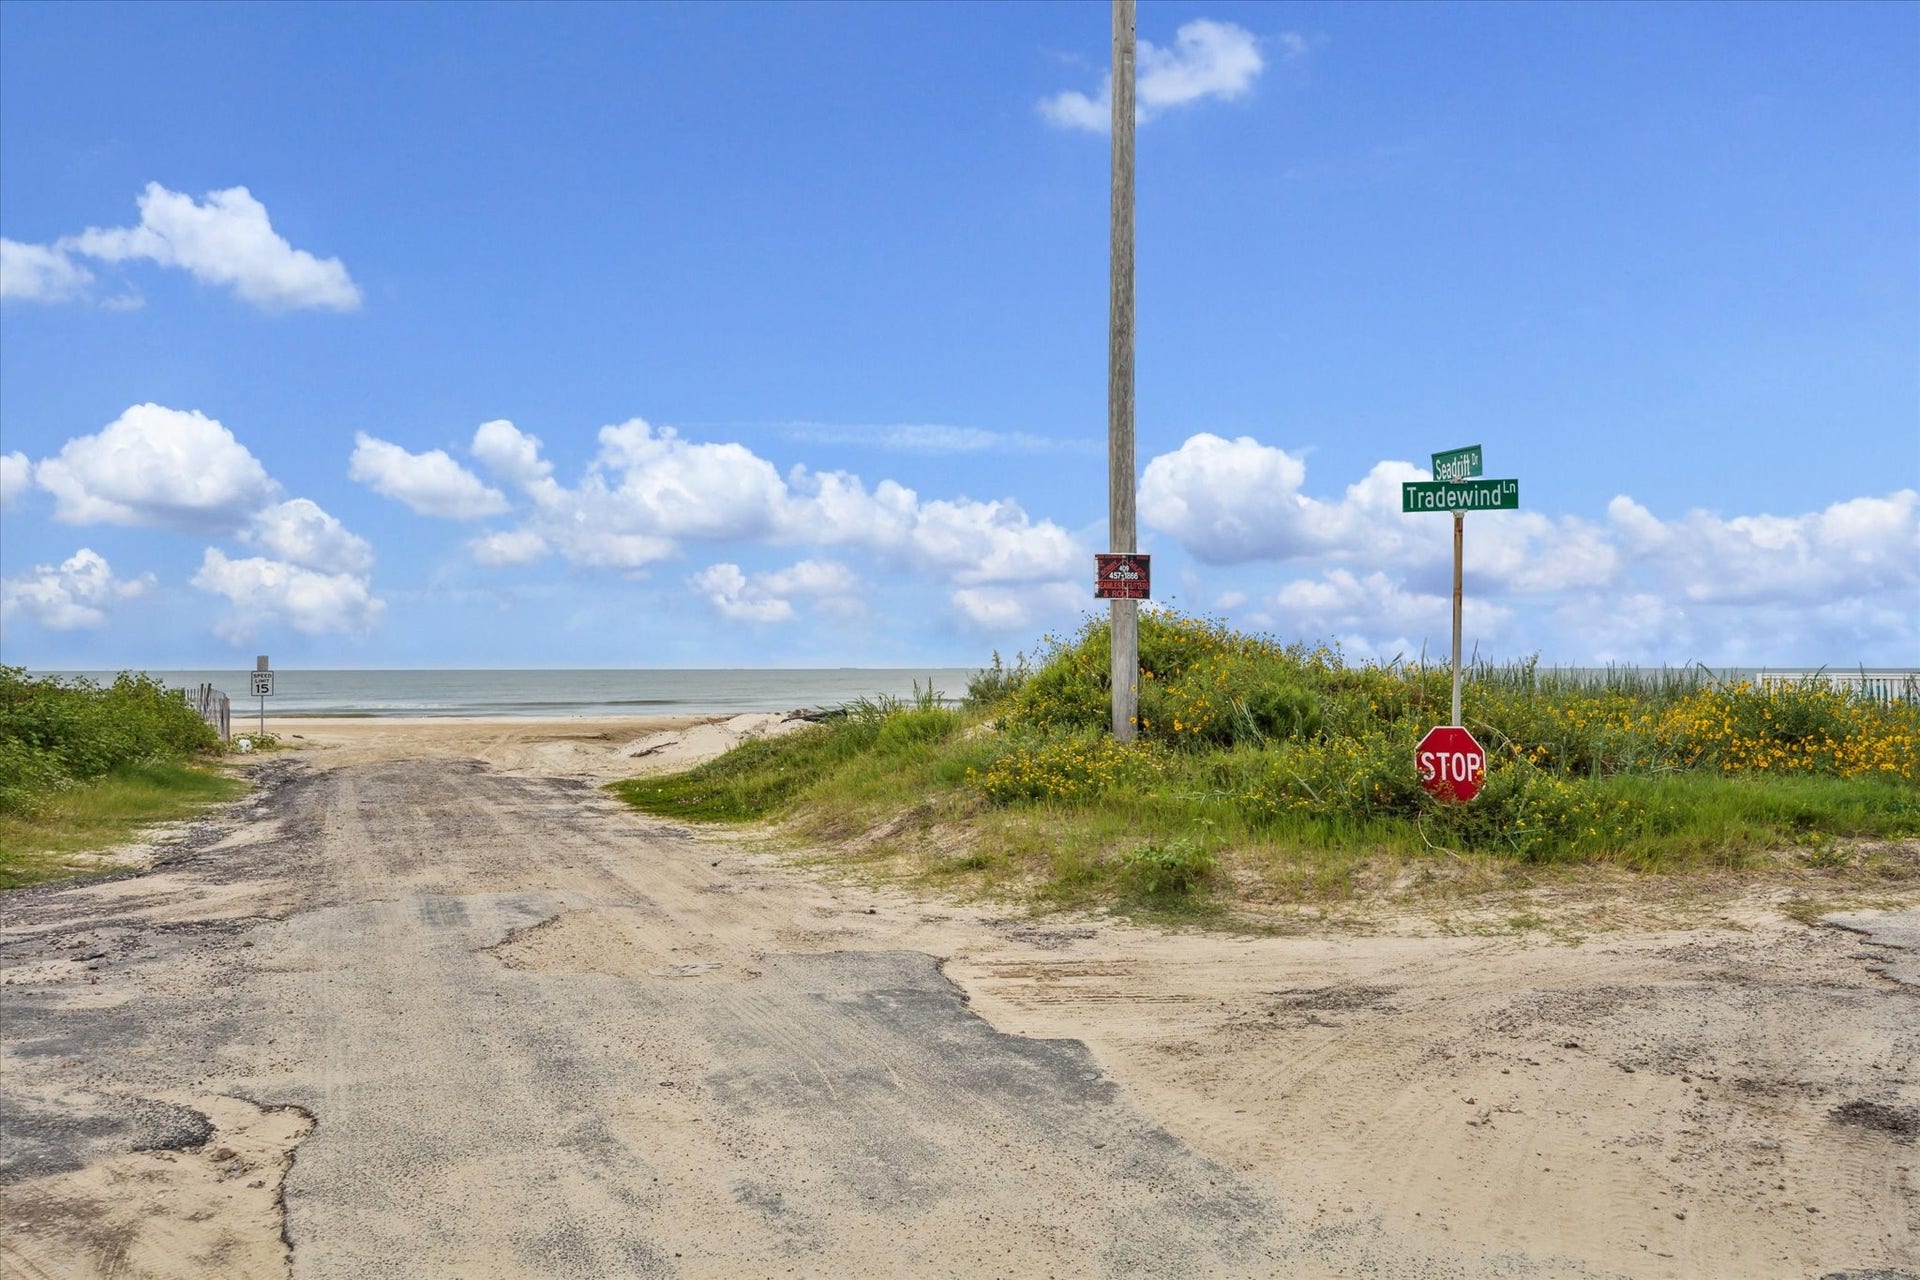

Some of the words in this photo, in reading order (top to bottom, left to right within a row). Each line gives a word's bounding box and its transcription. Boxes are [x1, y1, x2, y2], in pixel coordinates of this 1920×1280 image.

[1435, 454, 1470, 480] Seadrift
[1471, 453, 1479, 466] Dr
[1406, 484, 1501, 509] Tradewind
[1502, 480, 1516, 494] Ln
[256, 684, 269, 693] 15
[1421, 752, 1480, 781] STOP
